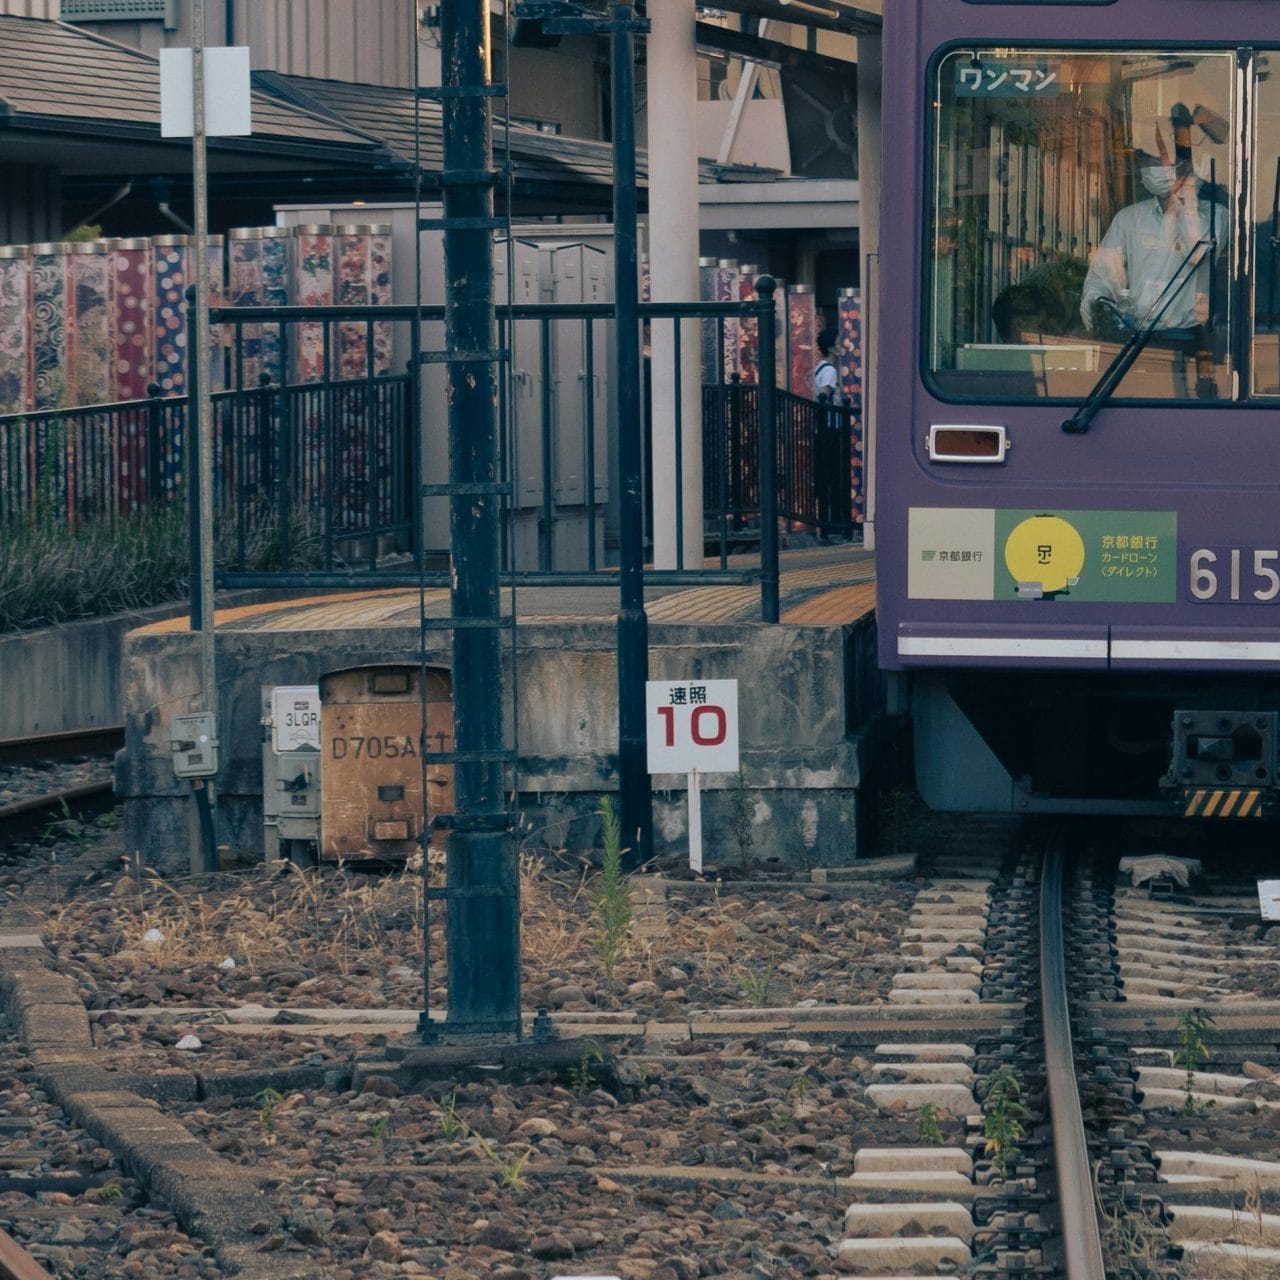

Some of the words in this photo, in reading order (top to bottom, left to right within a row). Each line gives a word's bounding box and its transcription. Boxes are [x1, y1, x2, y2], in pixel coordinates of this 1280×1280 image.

[960, 68, 1056, 92] ワンマン
[1102, 535, 1158, 549] 京都銀行
[939, 551, 983, 562] 京都銀行
[1102, 552, 1158, 563] カードローン
[1190, 549, 1280, 600] 615
[669, 686, 707, 705] 速照
[657, 705, 727, 747] 10
